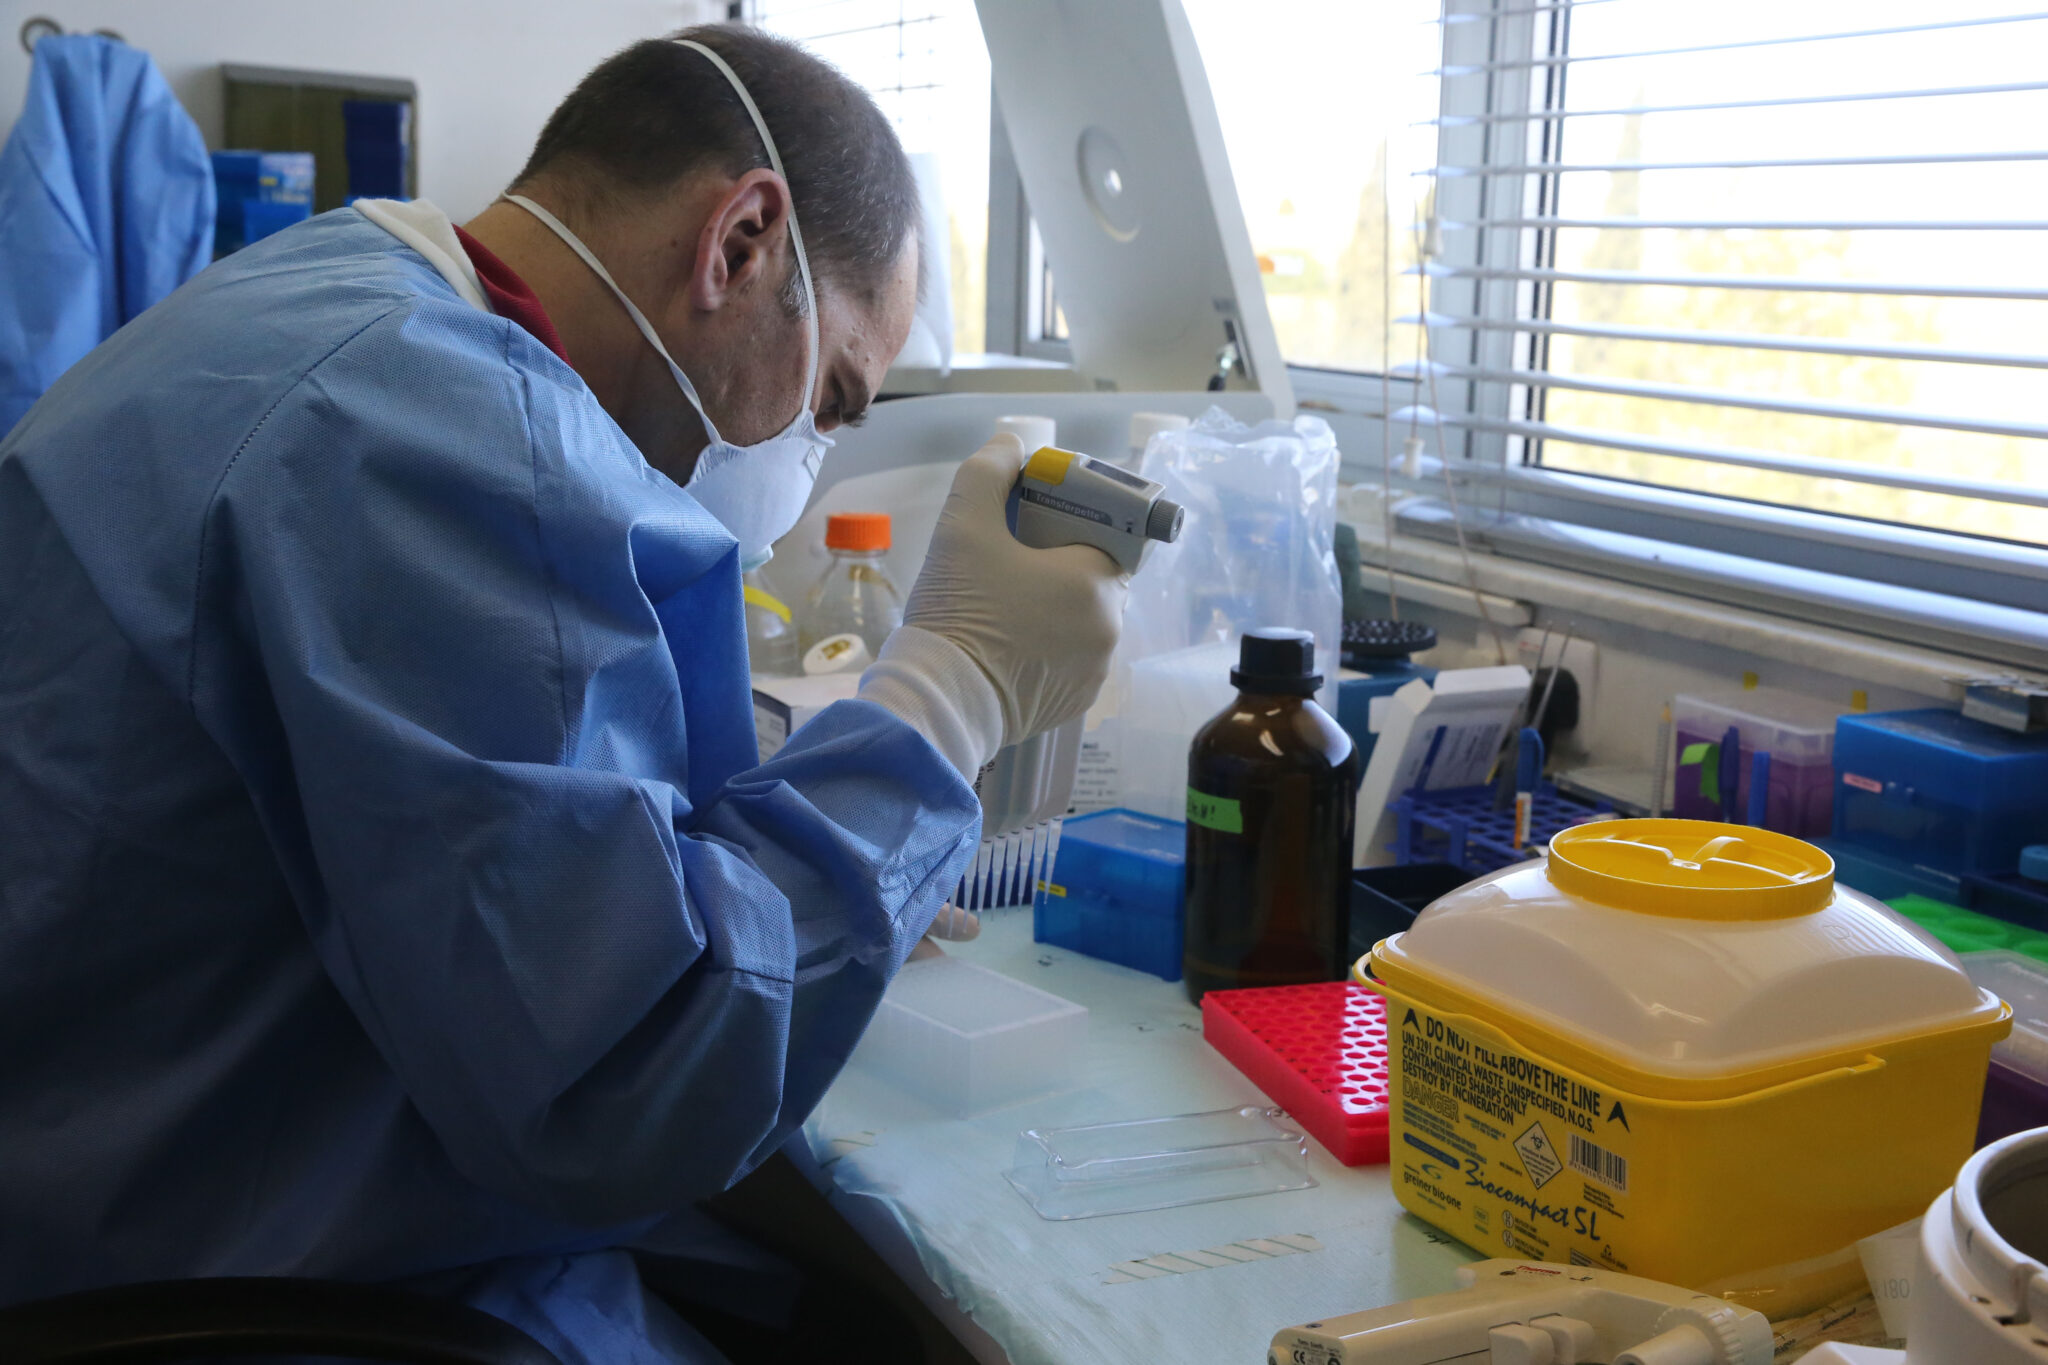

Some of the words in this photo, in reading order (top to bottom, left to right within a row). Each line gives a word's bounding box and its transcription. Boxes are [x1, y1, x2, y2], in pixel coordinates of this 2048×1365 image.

[1402, 1044, 1467, 1087] CONTAMINATED
[1469, 1076, 1502, 1104] SHARPS
[1503, 1094, 1527, 1117] ONLY
[1402, 1030, 1415, 1047] UN
[1416, 1036, 1432, 1055] 3291
[1434, 1045, 1473, 1076] CLINICAL
[1474, 1063, 1506, 1093] WASTE,
[1507, 1079, 1568, 1124] UNSPECIFIED,
[1568, 1108, 1595, 1134] N.O.S.
[1402, 1058, 1438, 1088] DESTROY
[1440, 1077, 1451, 1094] BY
[1452, 1083, 1514, 1126] INCINERATION
[1402, 1074, 1460, 1123] DANGER
[1427, 1016, 1444, 1042] DO
[1500, 1055, 1541, 1089] ABOVE
[1542, 1068, 1568, 1102] THE
[1571, 1082, 1601, 1117] LINE
[1403, 1171, 1432, 1194] greiner
[1464, 1158, 1569, 1227] Biocompact
